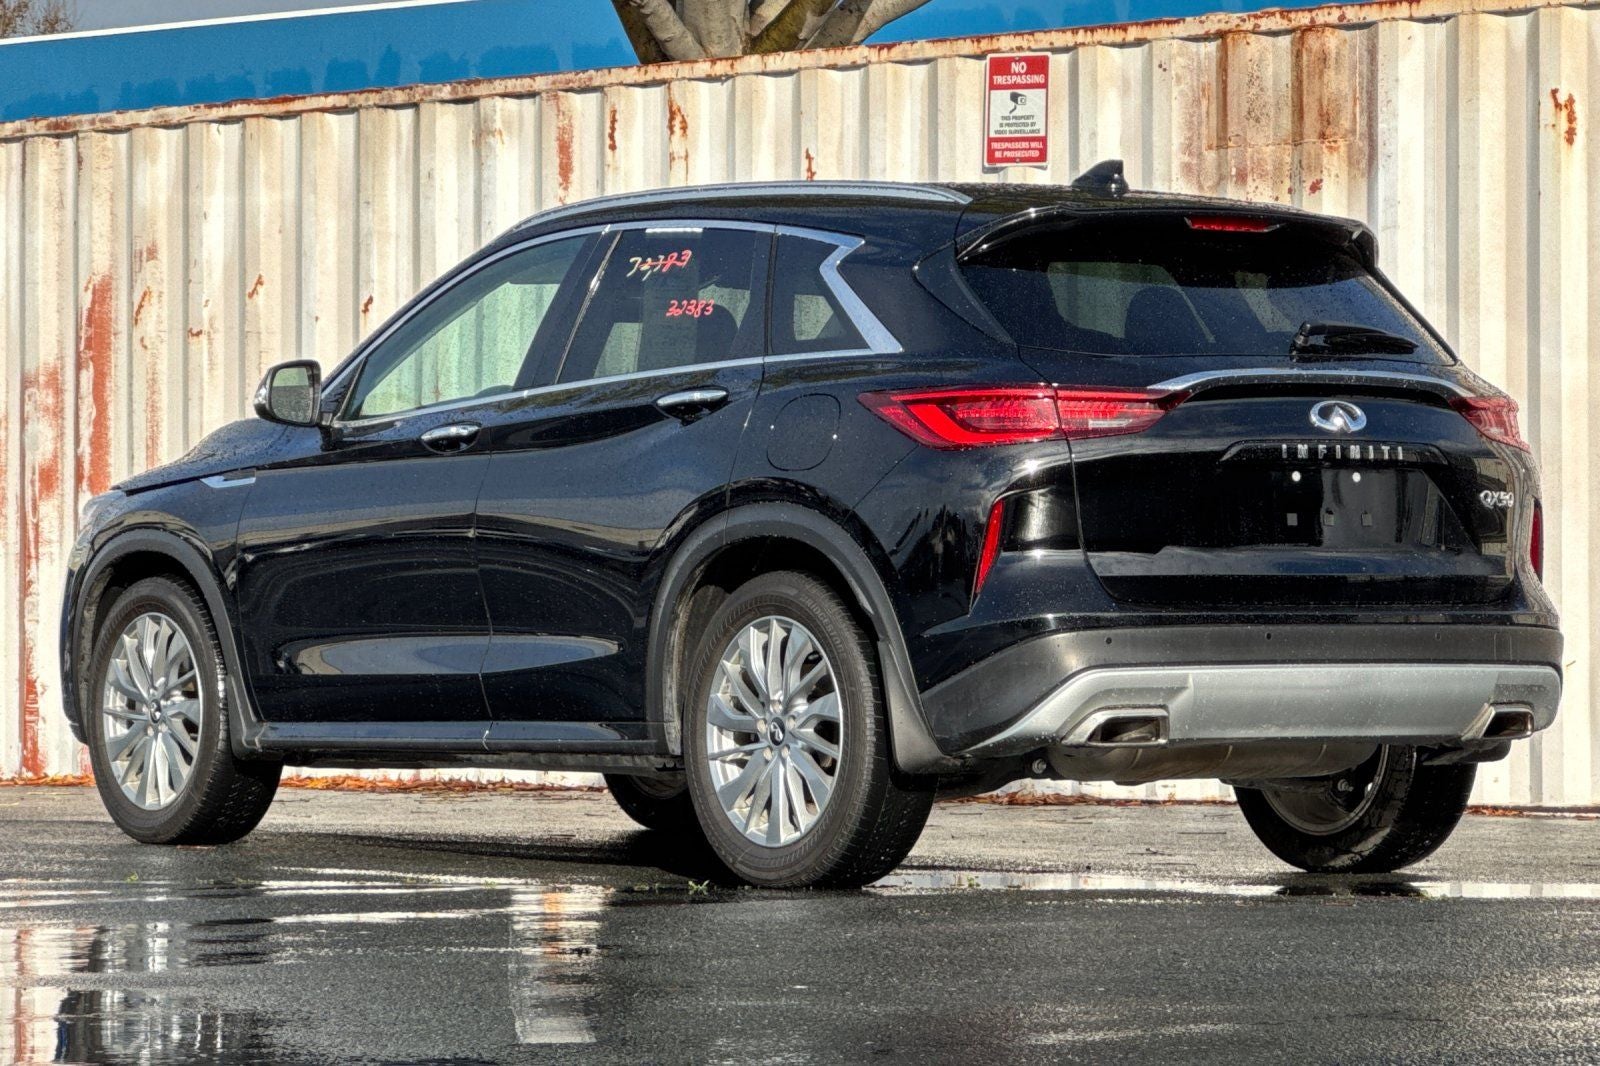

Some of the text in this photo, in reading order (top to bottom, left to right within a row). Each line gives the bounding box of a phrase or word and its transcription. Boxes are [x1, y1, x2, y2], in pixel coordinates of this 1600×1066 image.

[1011, 61, 1027, 74] NO
[992, 74, 1045, 85] TRESPASSING
[991, 141, 1044, 150] TRESPASSERS WILL
[994, 150, 1041, 159] BE PROSECUTED
[1281, 443, 1404, 461] INFINITI
[1479, 489, 1515, 508] QX50
